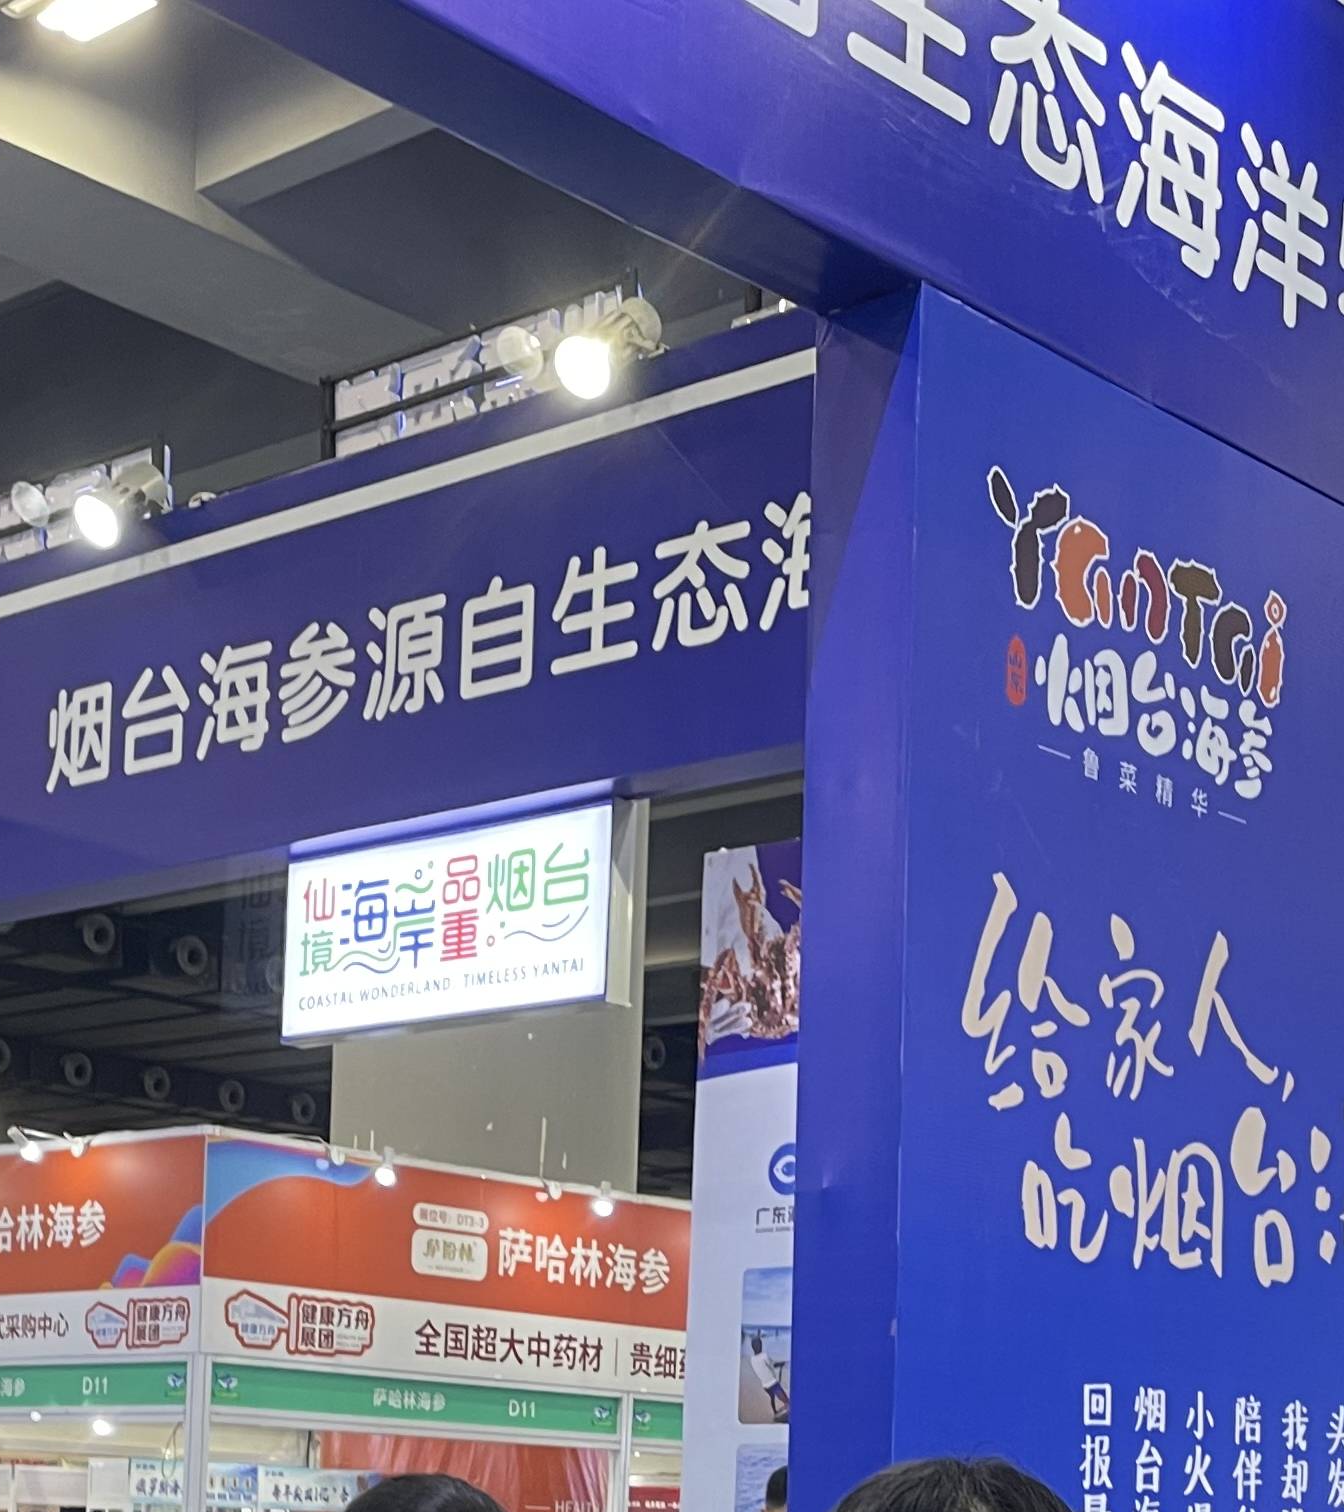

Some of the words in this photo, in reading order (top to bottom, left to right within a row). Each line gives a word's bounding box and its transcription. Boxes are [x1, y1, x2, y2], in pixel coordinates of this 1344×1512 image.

[1034, 633, 1273, 799] 烟台海参
[298, 992, 355, 1012] COASTAL
[359, 977, 452, 1003] WONDERLAND
[463, 967, 528, 988] TIMELESS
[533, 957, 586, 978] YANTAI
[497, 1226, 671, 1295] 萨哈林海参
[302, 1303, 370, 1330] 健康方舟
[301, 1327, 335, 1350] 展团
[414, 1319, 603, 1372] 全国超大中药材
[82, 1376, 109, 1397] D11
[372, 1387, 447, 1413] 萨哈林海参
[507, 1398, 537, 1419] D11
